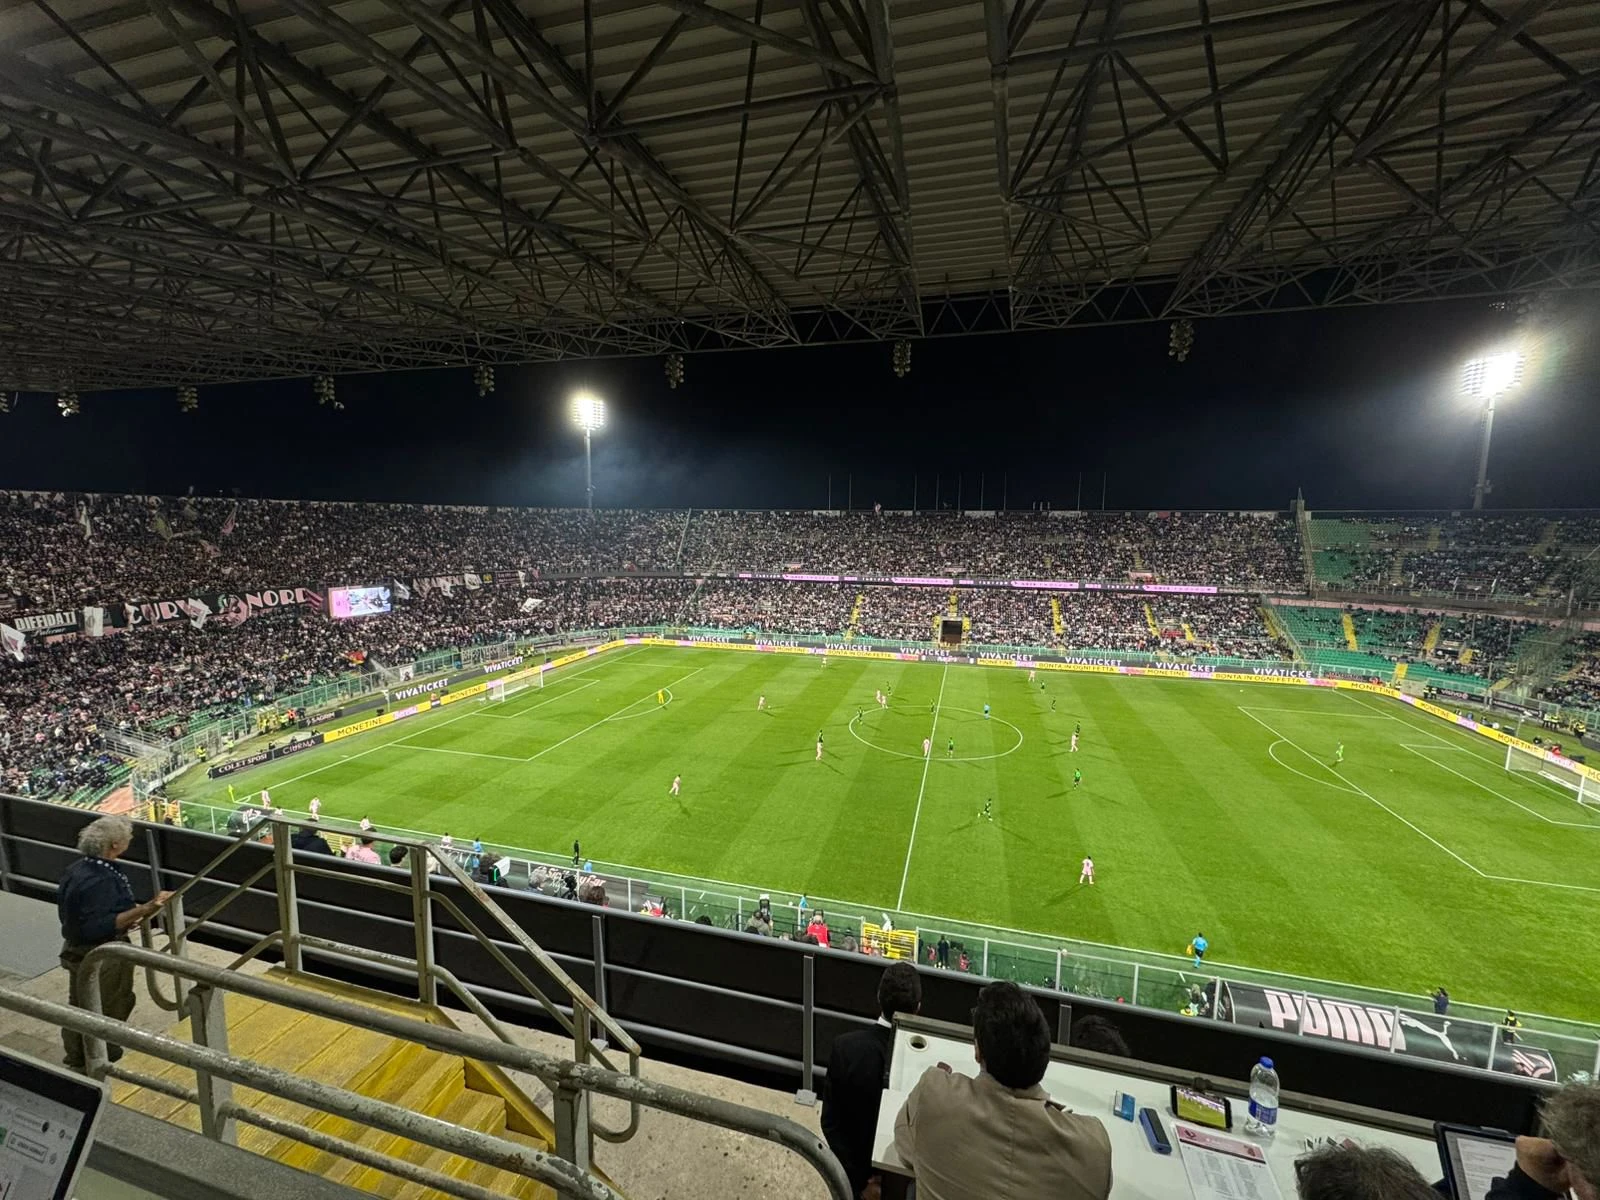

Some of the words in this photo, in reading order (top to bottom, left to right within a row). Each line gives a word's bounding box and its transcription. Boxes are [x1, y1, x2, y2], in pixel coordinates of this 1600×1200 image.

[14, 611, 77, 631] DIFFIDATI
[755, 639, 799, 647] VIVATICKET
[825, 643, 872, 651] VIVATICKET
[900, 647, 950, 656] VIVATICKET
[980, 652, 1033, 661] VIVATICKET
[484, 656, 523, 674] VIVATICKET
[1065, 656, 1121, 666] VIVATICKET
[1155, 662, 1216, 672] VIVATICKET
[395, 678, 448, 700] VIVATICKET
[1351, 682, 1395, 695] MONETINE
[1421, 702, 1450, 718] MONETINE
[337, 717, 383, 737] MONETINE
[1497, 732, 1539, 753] MONETINE
[247, 753, 267, 764] SPOSI
[1263, 989, 1407, 1051] PUMA
